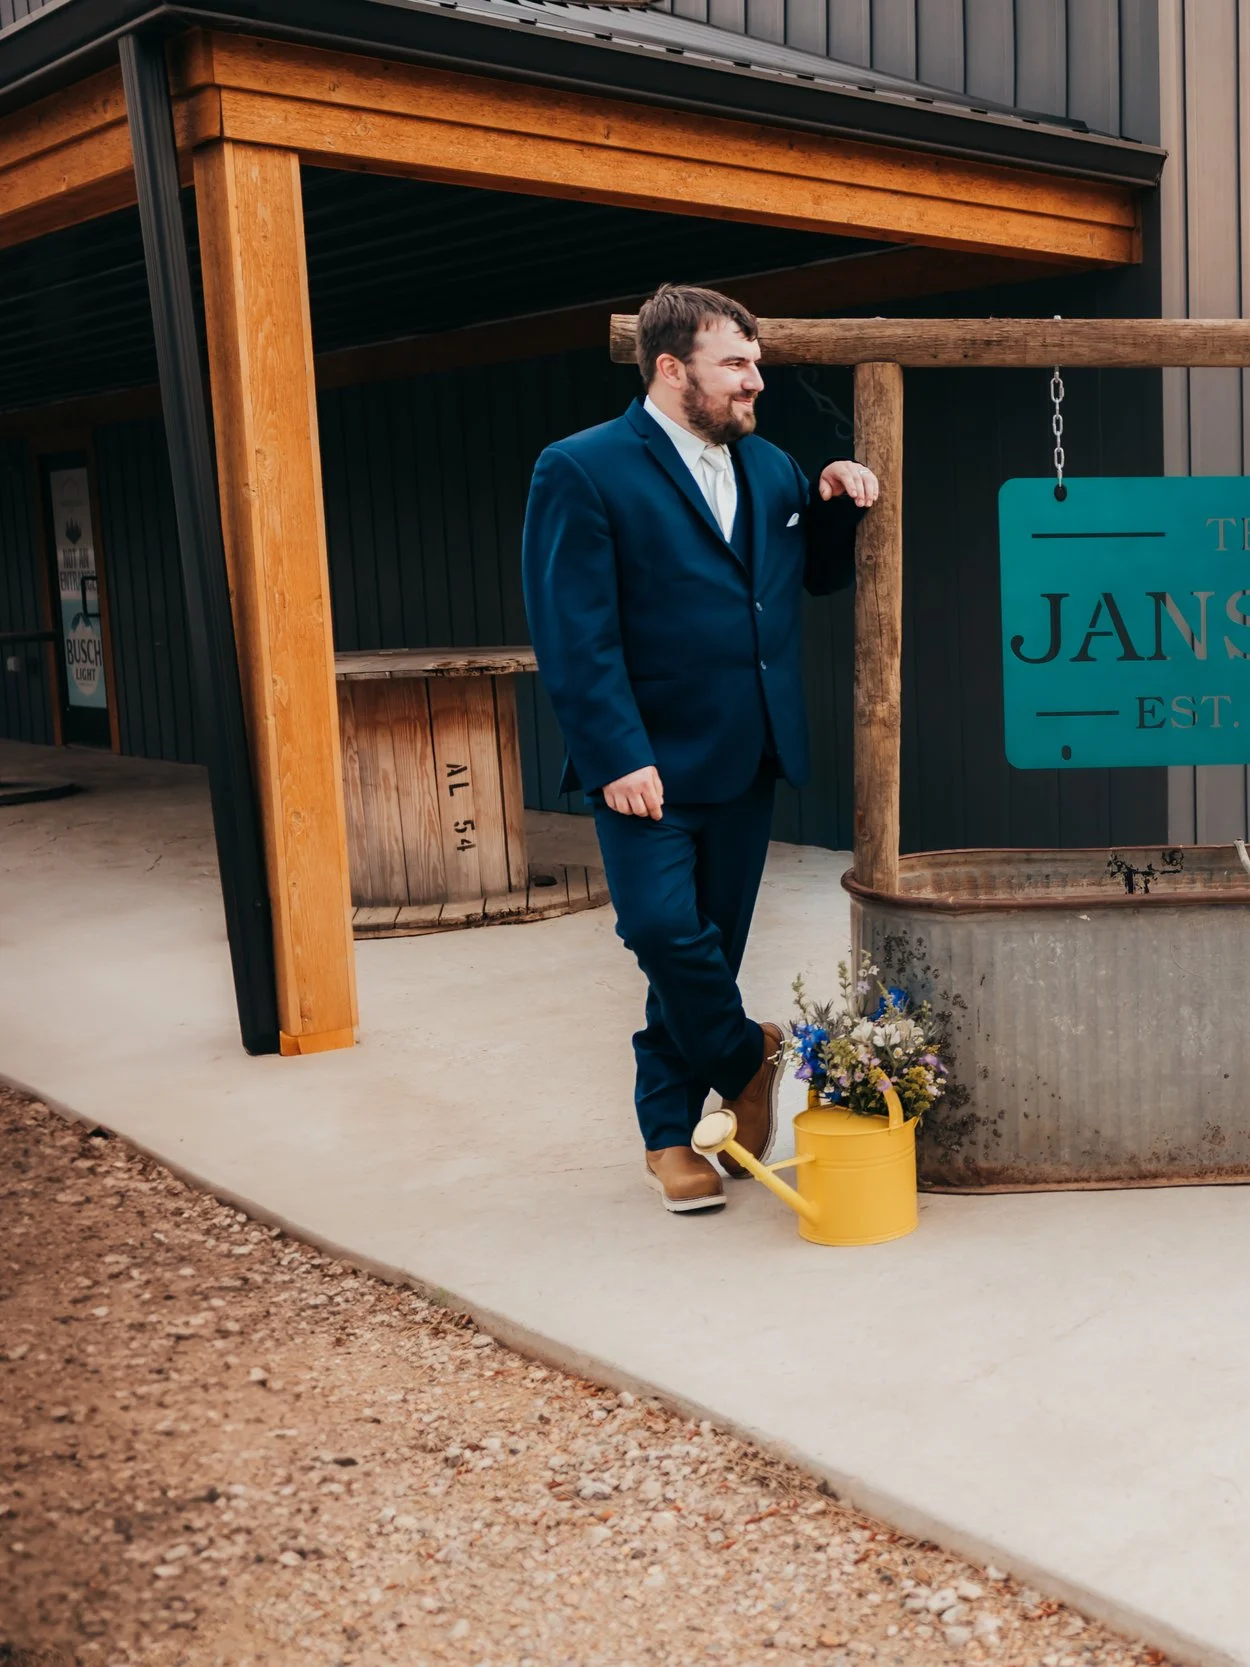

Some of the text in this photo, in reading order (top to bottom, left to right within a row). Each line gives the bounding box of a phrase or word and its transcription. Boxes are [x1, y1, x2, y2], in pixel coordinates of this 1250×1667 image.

[66, 639, 102, 666] BUSCH
[75, 668, 96, 681] LIGHT
[1136, 695, 1240, 729] EST.
[446, 763, 476, 852] AL 54
